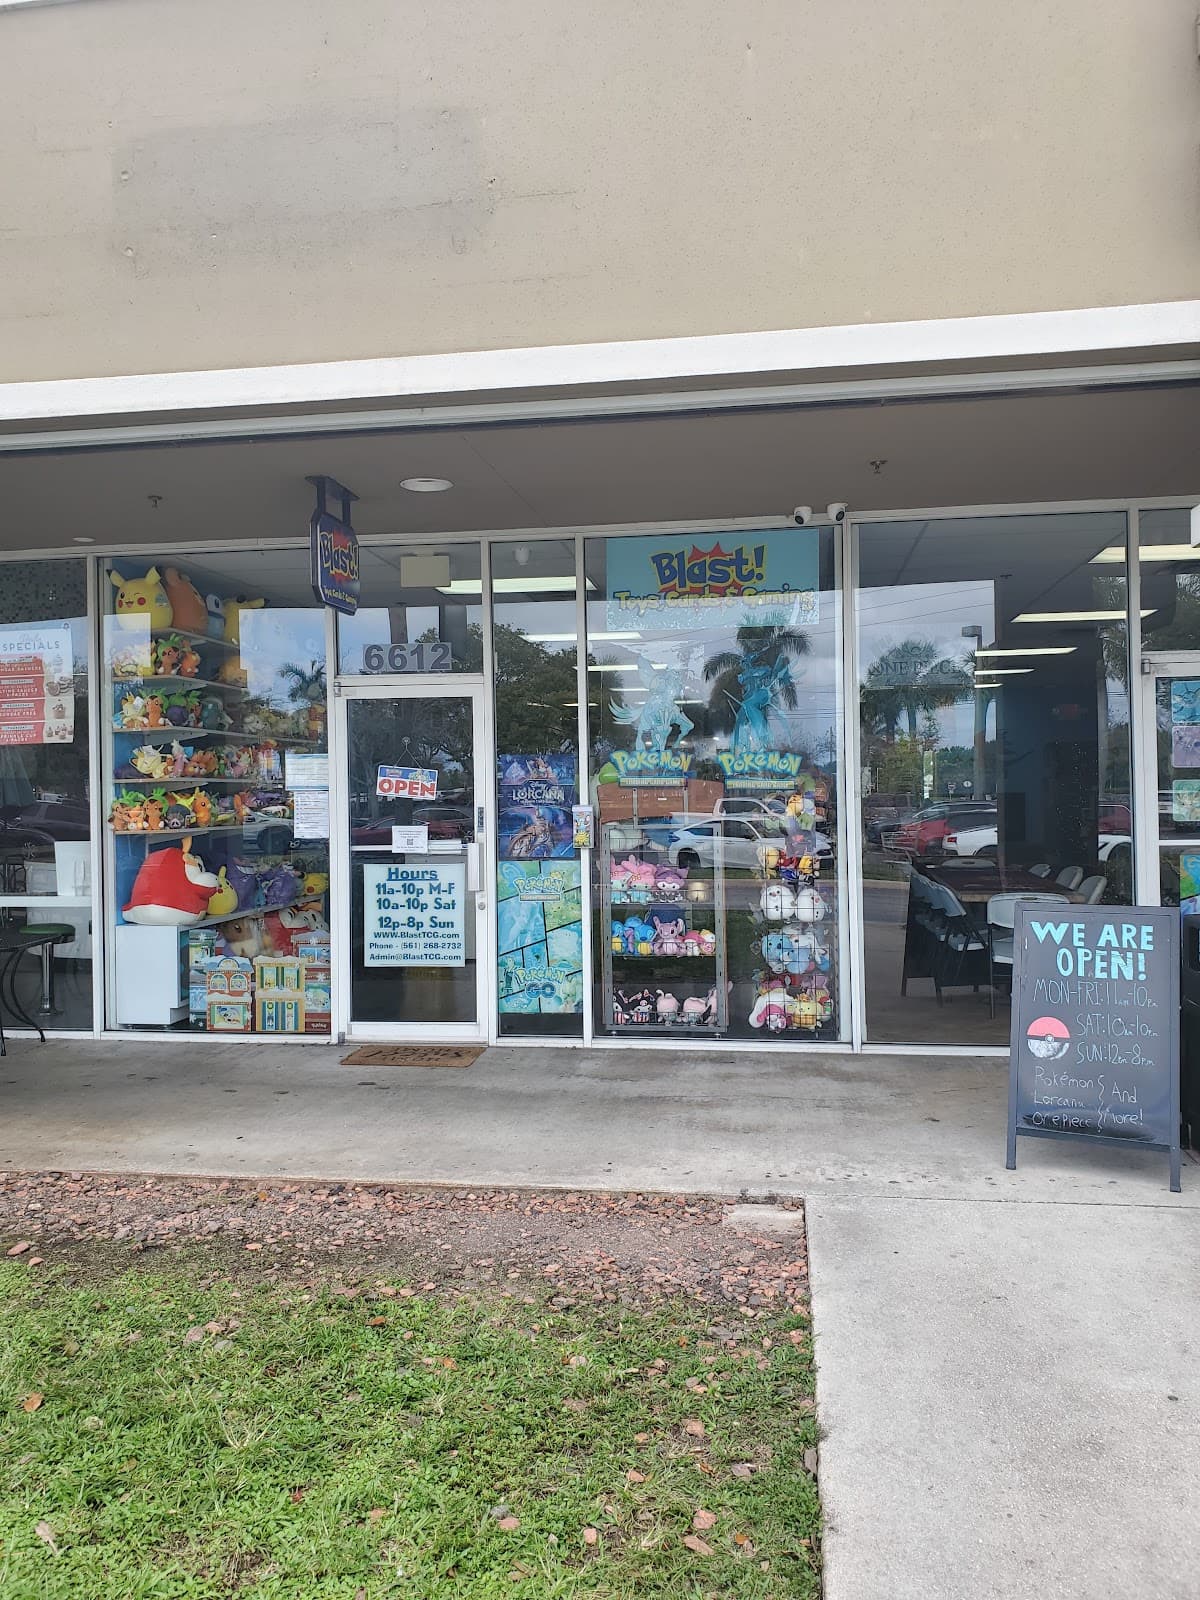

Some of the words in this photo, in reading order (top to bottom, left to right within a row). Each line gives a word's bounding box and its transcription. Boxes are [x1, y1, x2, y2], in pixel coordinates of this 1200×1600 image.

[651, 543, 767, 588] Blast!
[665, 584, 722, 608] Cards
[2, 641, 60, 652] SPECIALS
[364, 644, 450, 671] 6612
[379, 779, 435, 796] OPEN
[387, 867, 438, 880] Hours
[376, 883, 424, 897] 11a-10p
[429, 883, 455, 894] M-F
[377, 898, 428, 912] 10a-10p
[434, 898, 456, 910] Sat
[378, 916, 424, 930] 12p-8p
[430, 916, 454, 928] Sun
[1030, 921, 1085, 947] WE
[1096, 924, 1154, 950] ARE
[369, 942, 393, 950] Phone
[1056, 948, 1147, 981] OPEN!
[1112, 1081, 1137, 1104] And
